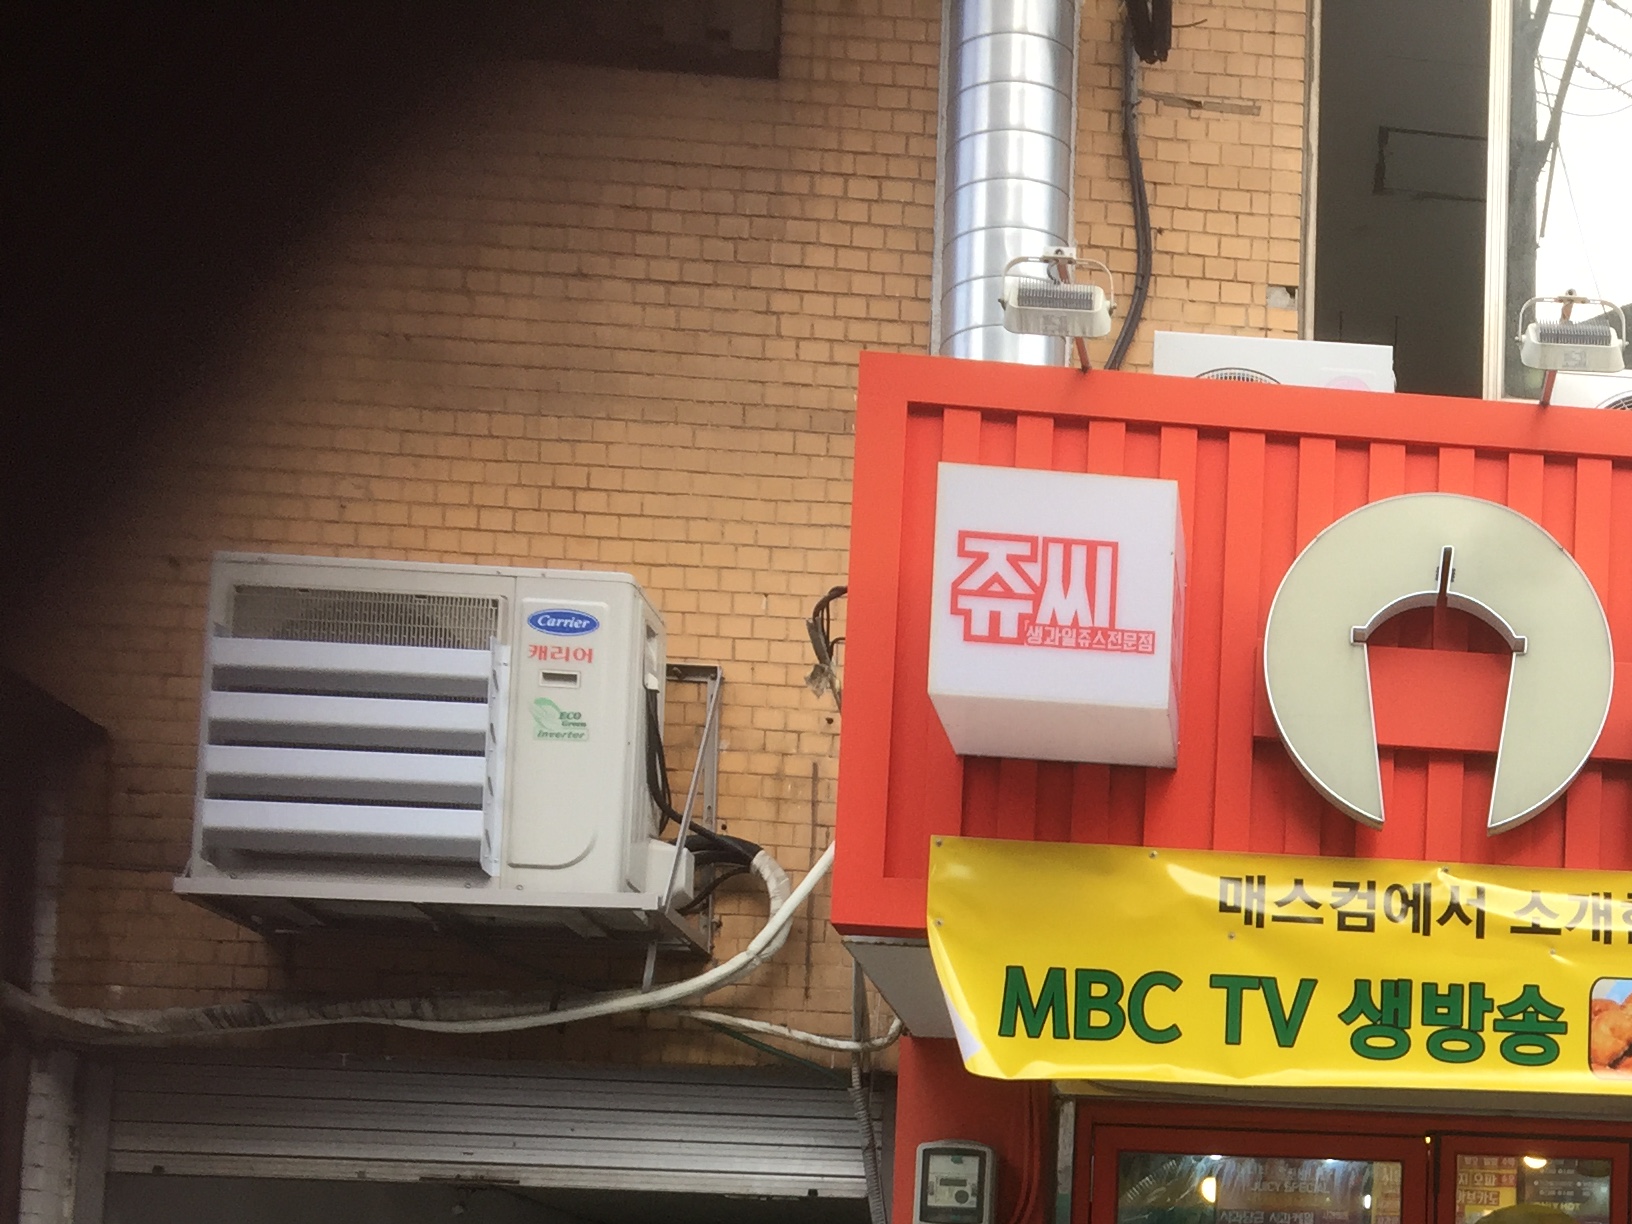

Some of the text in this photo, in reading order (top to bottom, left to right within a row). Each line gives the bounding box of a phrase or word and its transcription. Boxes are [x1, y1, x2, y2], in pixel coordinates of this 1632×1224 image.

[951, 530, 1118, 644] 쥬씨
[536, 614, 591, 629] Carrier
[1026, 624, 1154, 651] 생과일쥬스전문점
[528, 644, 594, 664] 캐리어
[559, 712, 582, 721] ECO
[1219, 875, 1486, 939] 매스컴에서
[997, 965, 1183, 1045] MBC
[1209, 973, 1318, 1049] TV
[1338, 977, 1569, 1067] 생방송
